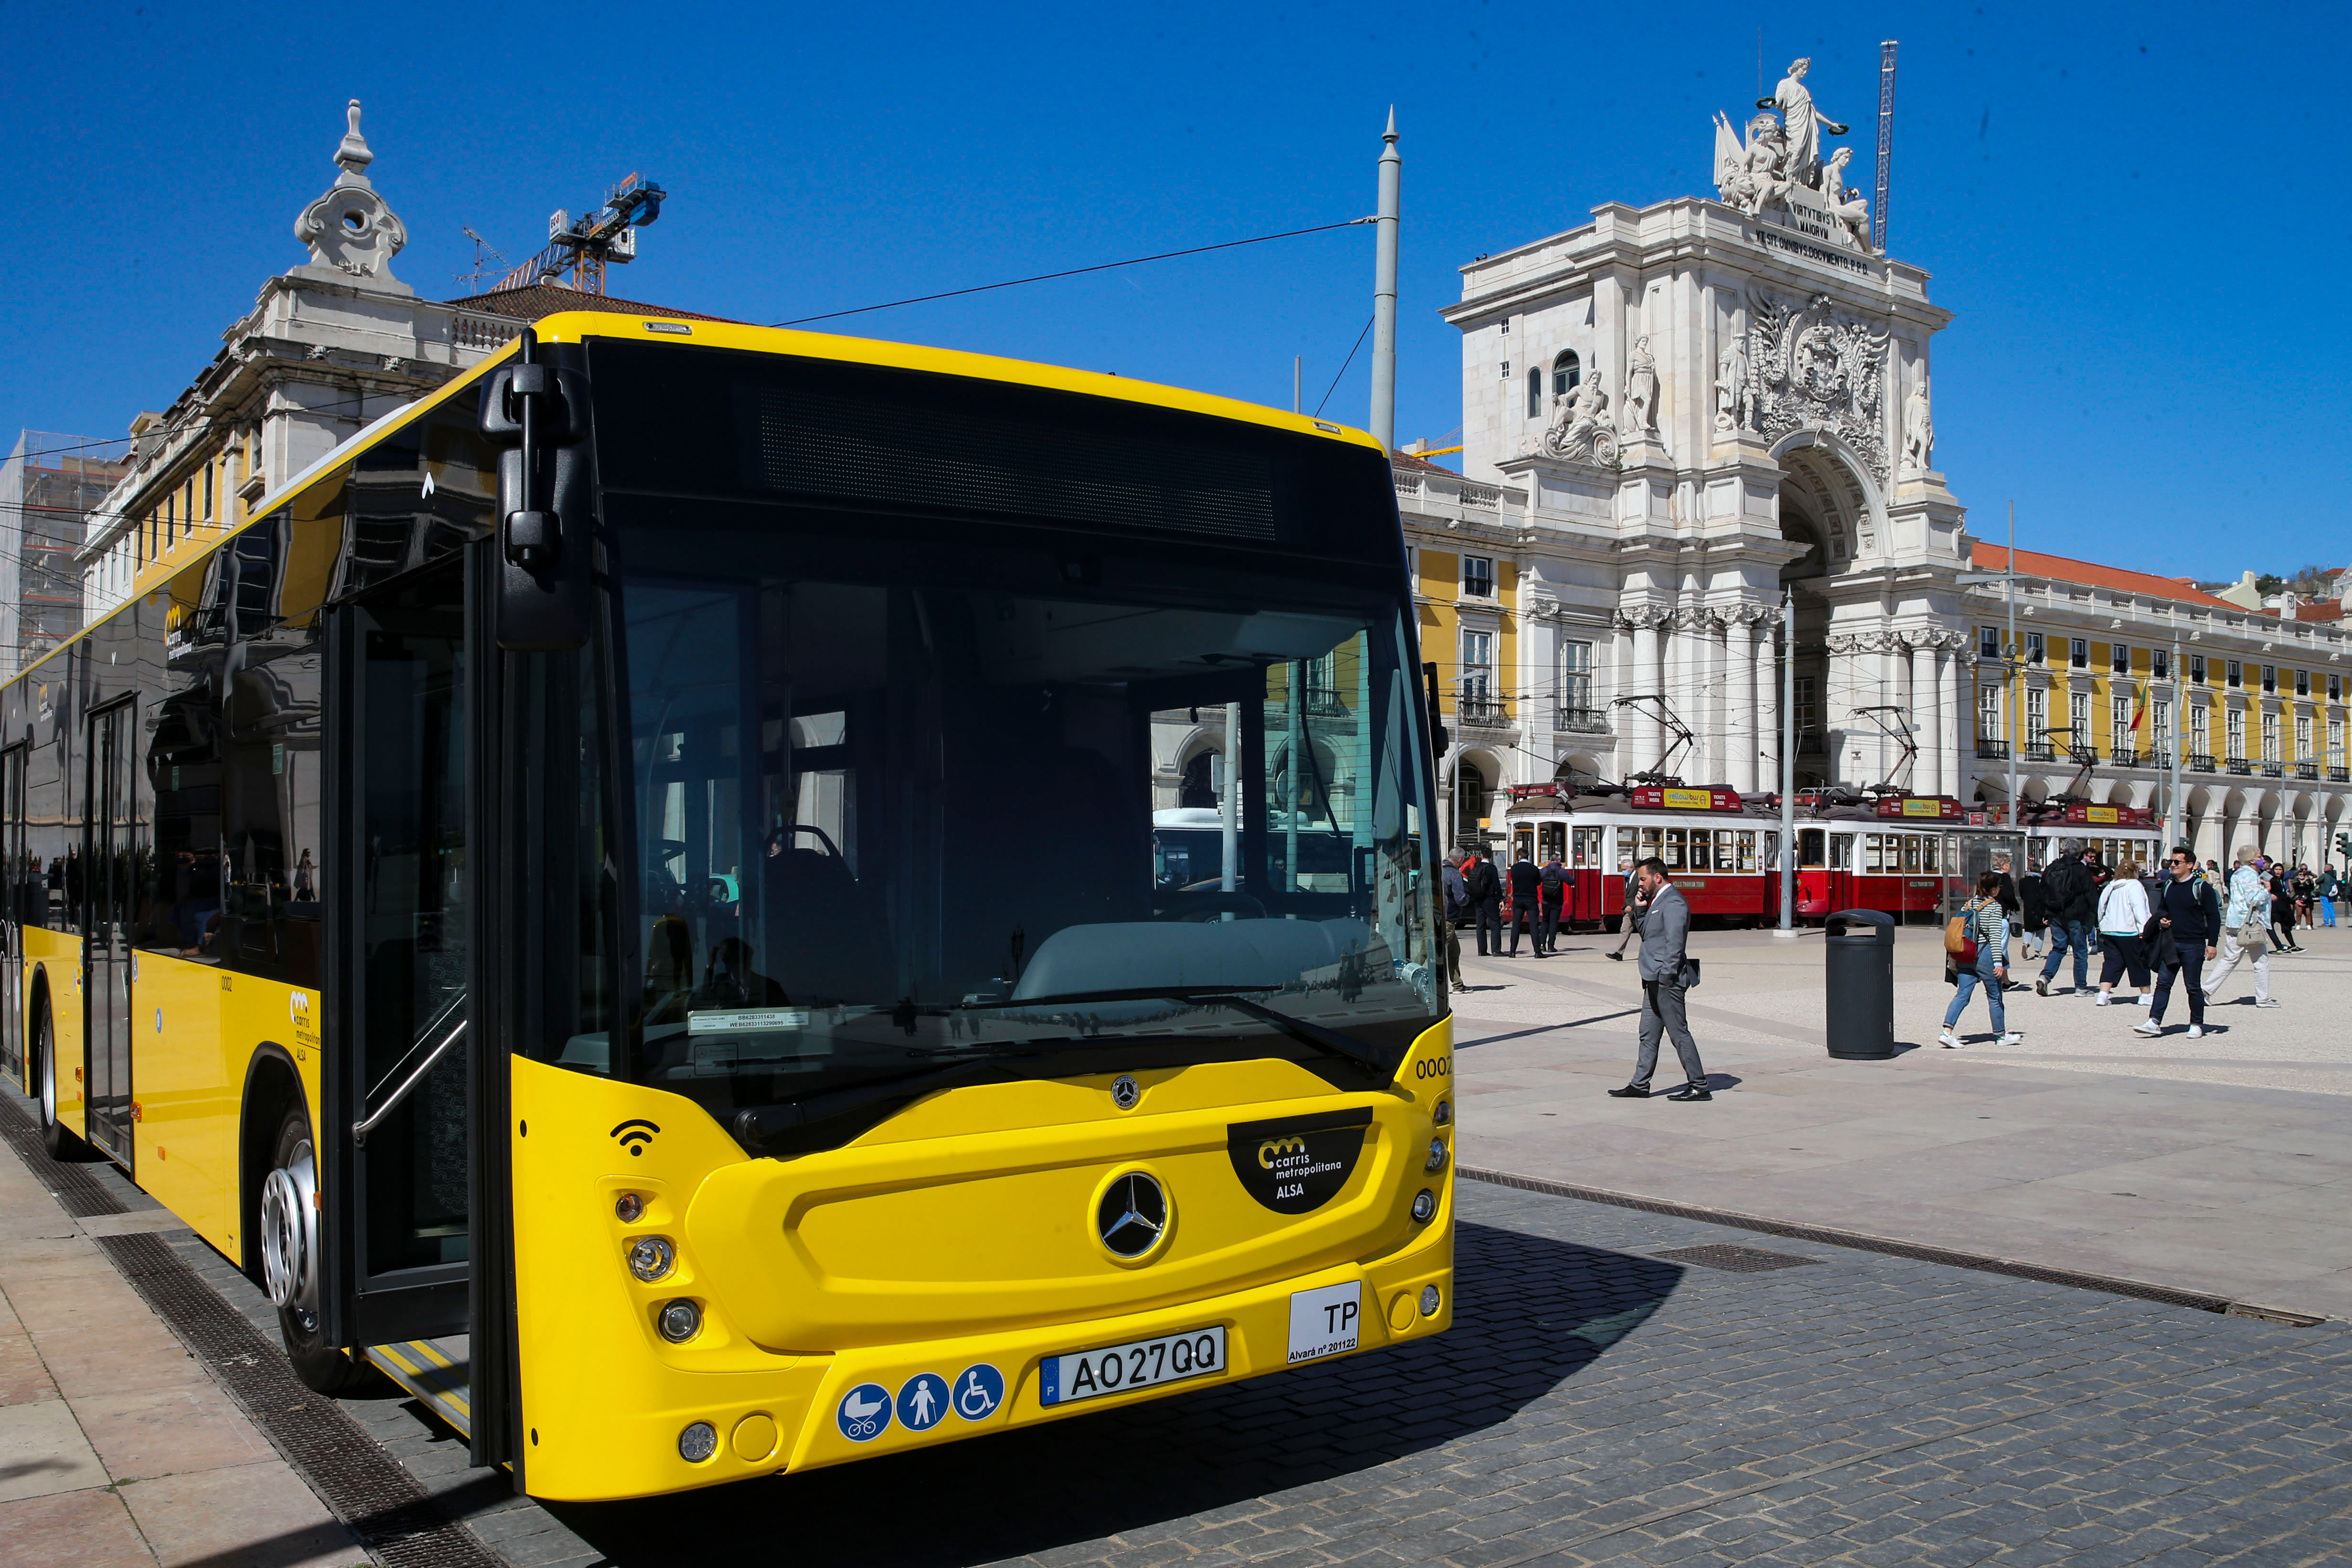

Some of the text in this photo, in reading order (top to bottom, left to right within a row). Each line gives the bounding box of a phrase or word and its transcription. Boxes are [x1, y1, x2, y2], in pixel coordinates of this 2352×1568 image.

[222, 976, 232, 992] 0002
[296, 1015, 310, 1028] carris
[297, 1048, 306, 1062] ALSA
[1416, 1055, 1453, 1079] 0002
[1276, 1154, 1310, 1168] carris
[1276, 1161, 1341, 1179] metropolitana
[1276, 1183, 1304, 1199] ALSA
[1324, 1301, 1358, 1333] TP
[1289, 1347, 1315, 1361] Alvará
[1328, 1338, 1356, 1352] 201122
[1047, 1386, 1054, 1397] P
